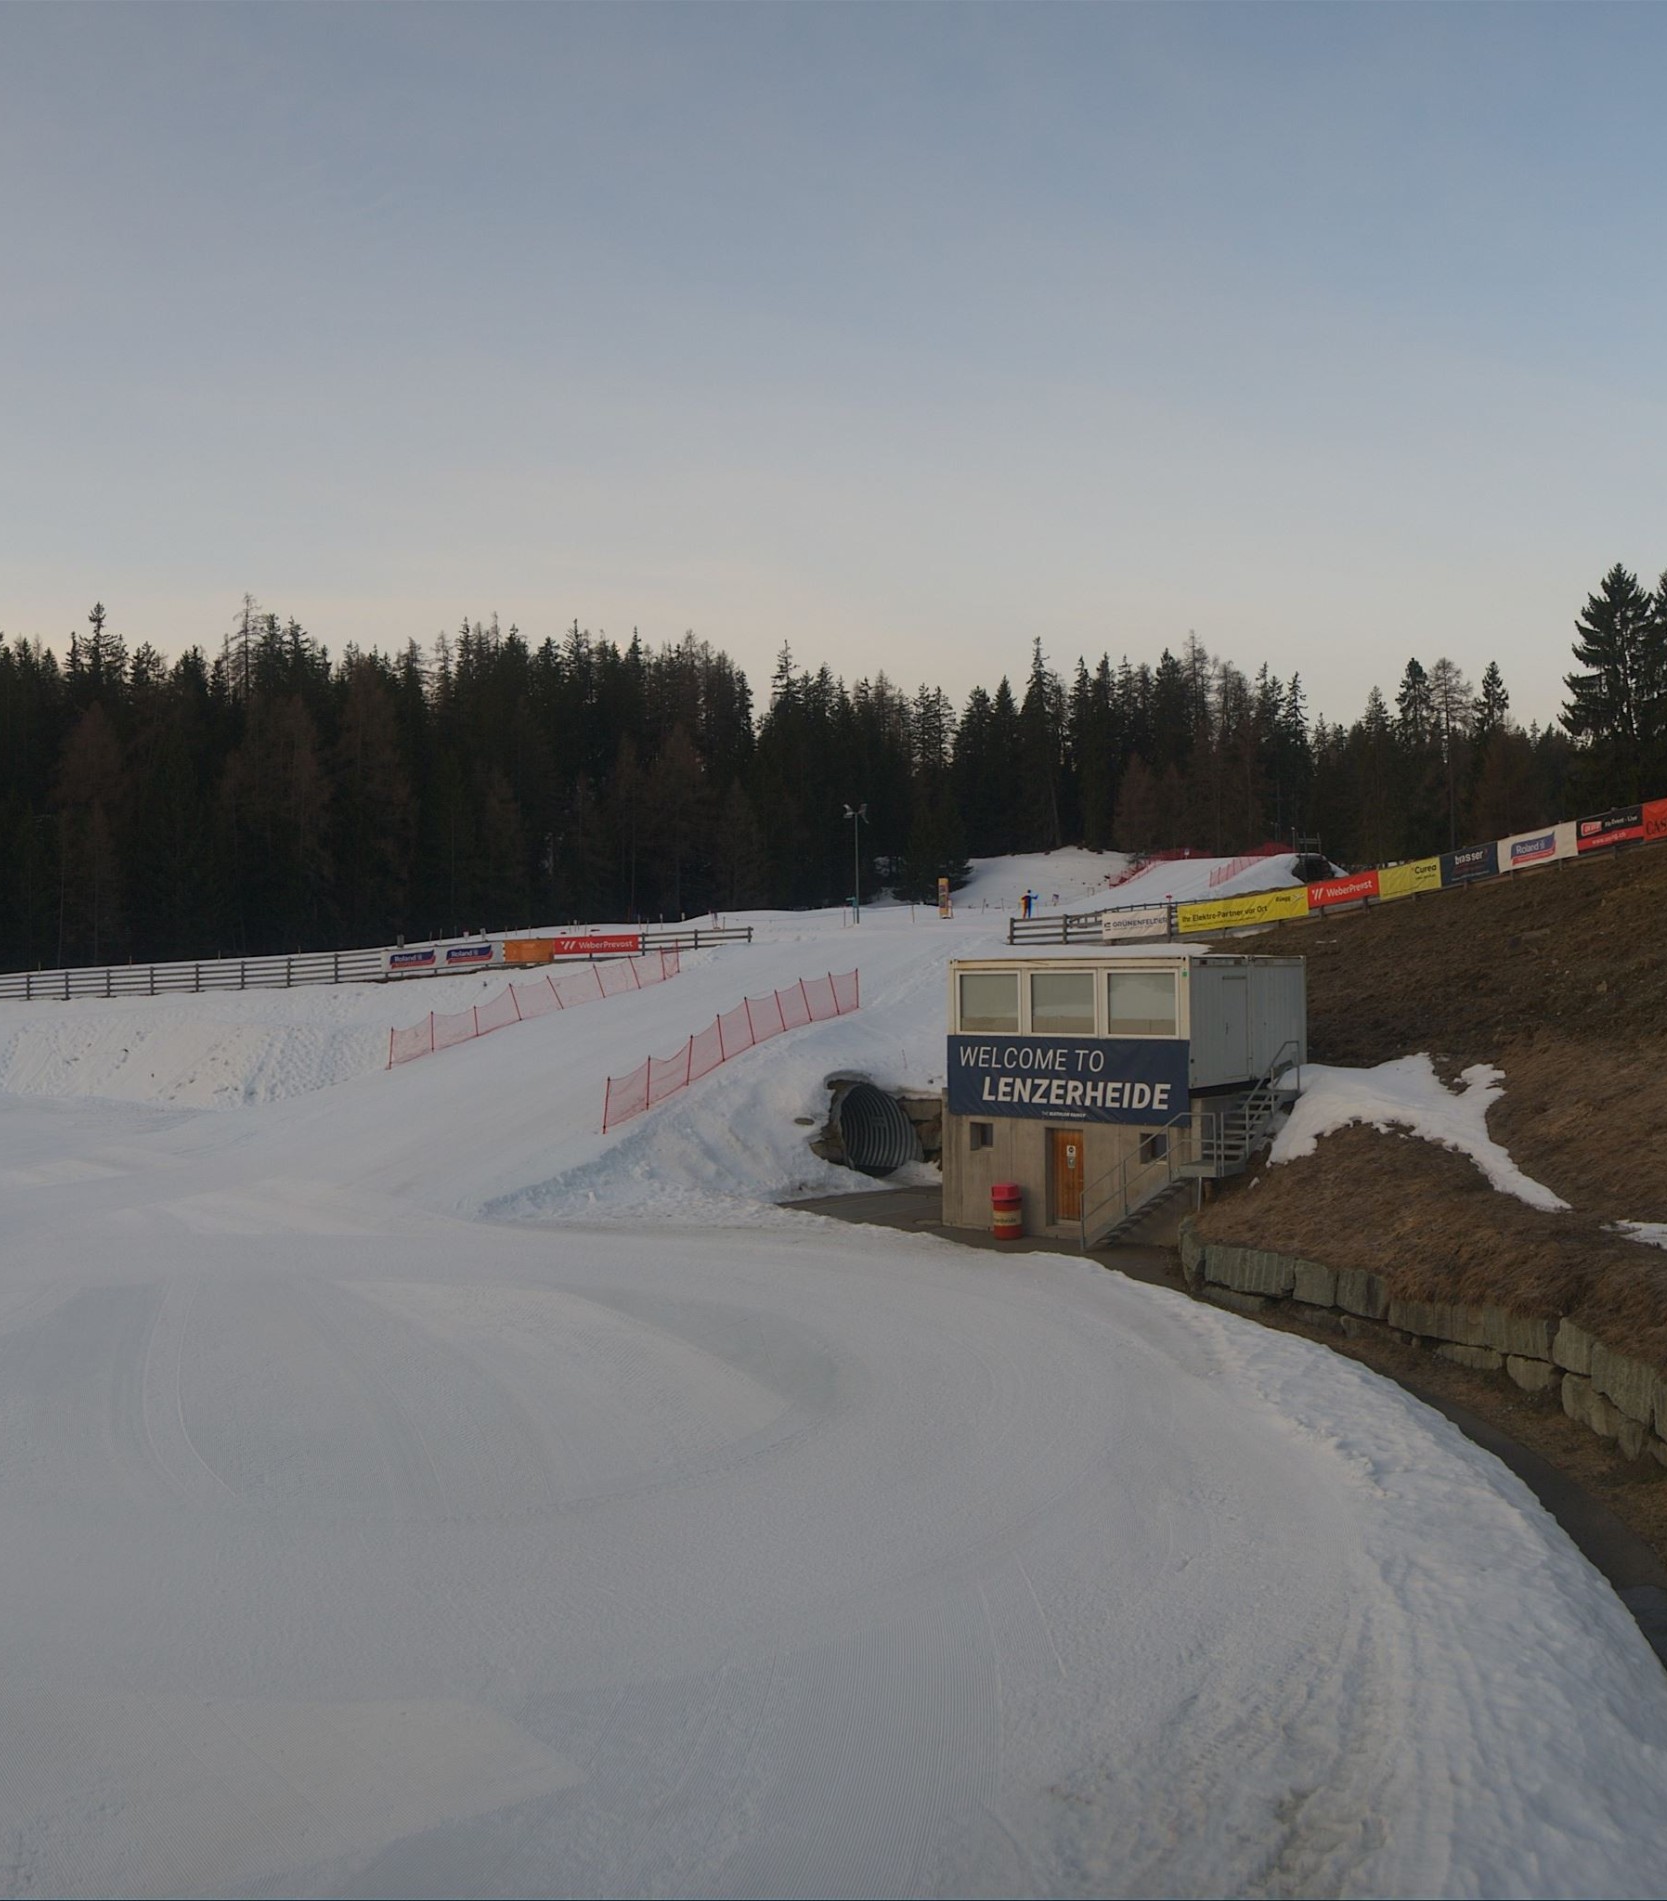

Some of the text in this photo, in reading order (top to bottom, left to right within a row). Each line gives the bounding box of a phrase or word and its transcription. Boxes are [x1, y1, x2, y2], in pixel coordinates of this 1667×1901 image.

[1515, 842, 1539, 854] Roland
[578, 939, 634, 951] WeberPrevost
[394, 953, 416, 963] Roland
[450, 949, 473, 959] Roland
[959, 1046, 1105, 1073] WELCOME TO
[982, 1076, 1172, 1110] LENZERHEIDE
